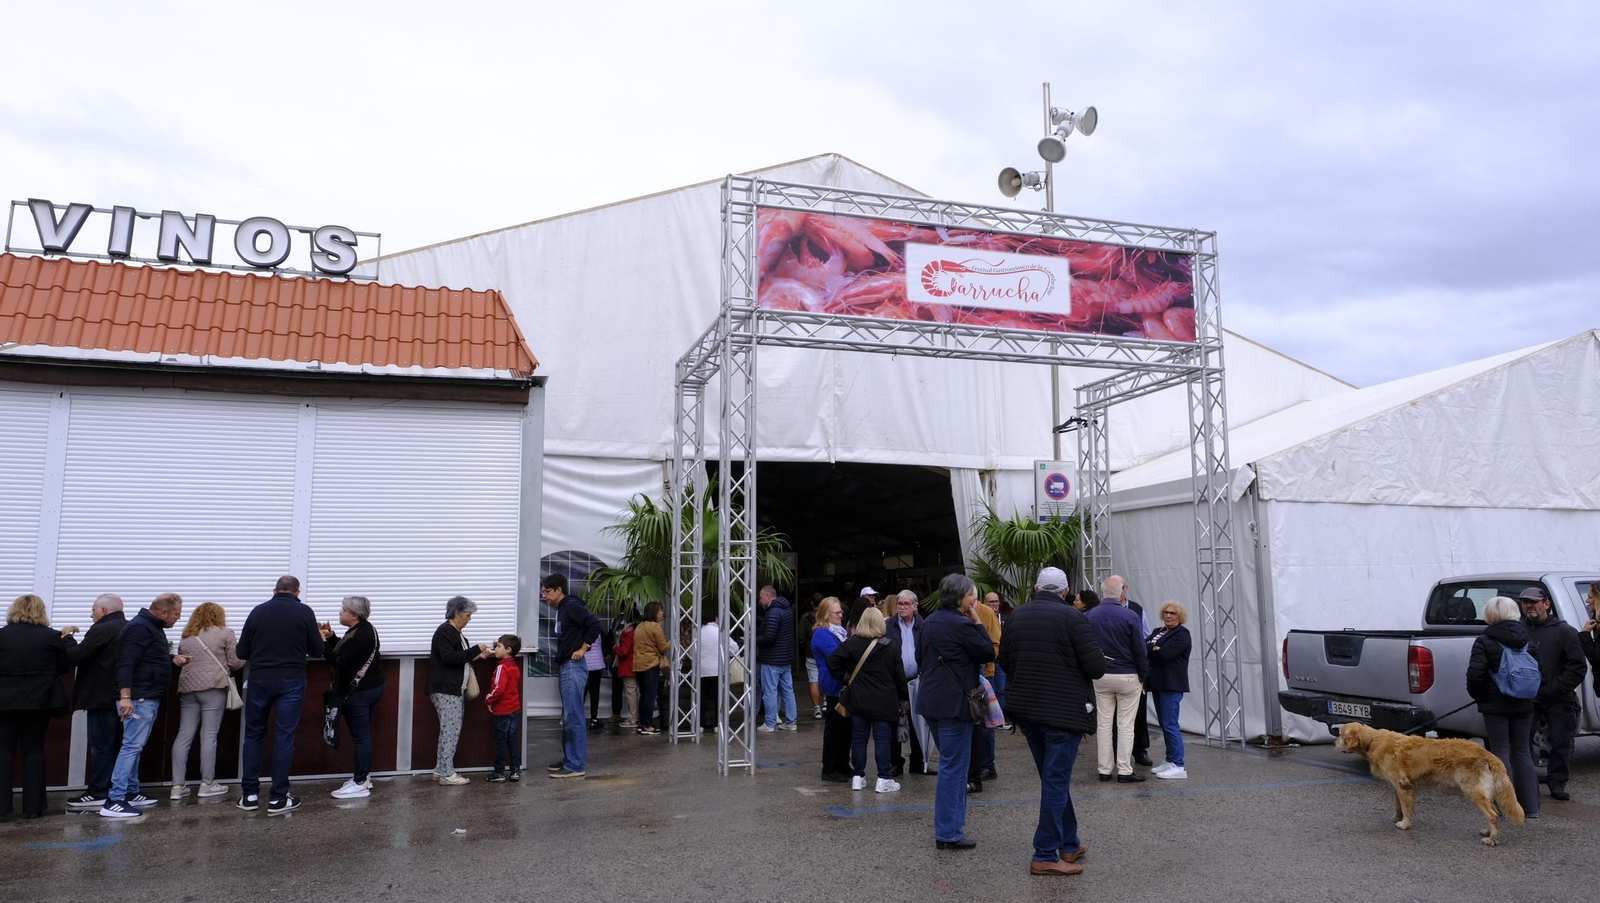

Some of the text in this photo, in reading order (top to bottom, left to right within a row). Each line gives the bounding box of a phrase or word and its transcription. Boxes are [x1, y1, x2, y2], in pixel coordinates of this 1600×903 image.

[28, 198, 358, 274] VINOS
[971, 265, 993, 273] Festival
[993, 264, 1029, 273] Gastronómico
[1333, 703, 1370, 716] 3649 FYB
